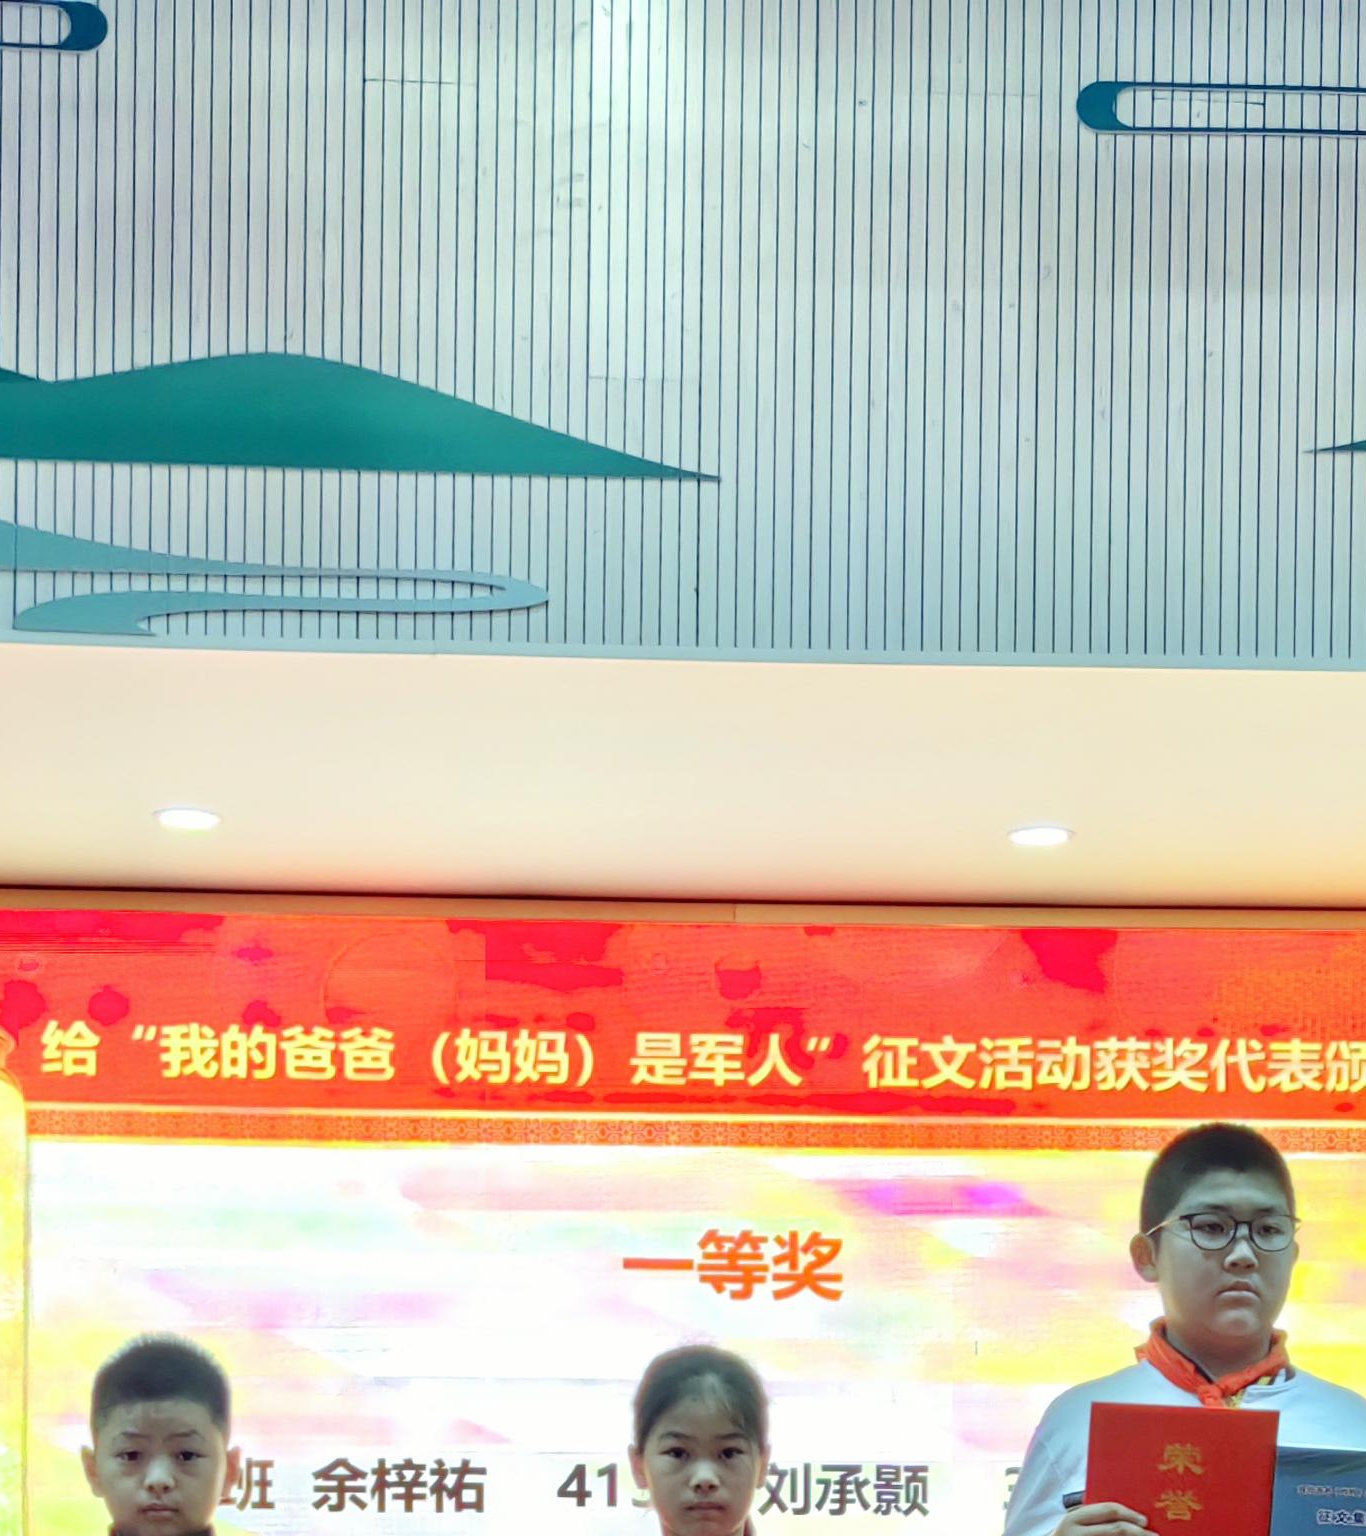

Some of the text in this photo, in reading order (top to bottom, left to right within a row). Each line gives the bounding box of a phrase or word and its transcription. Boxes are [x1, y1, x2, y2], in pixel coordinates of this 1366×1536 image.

[622, 1229, 845, 1302] 一等奖
[311, 1457, 488, 1514] 余梓祐
[556, 1463, 653, 1508] 41
